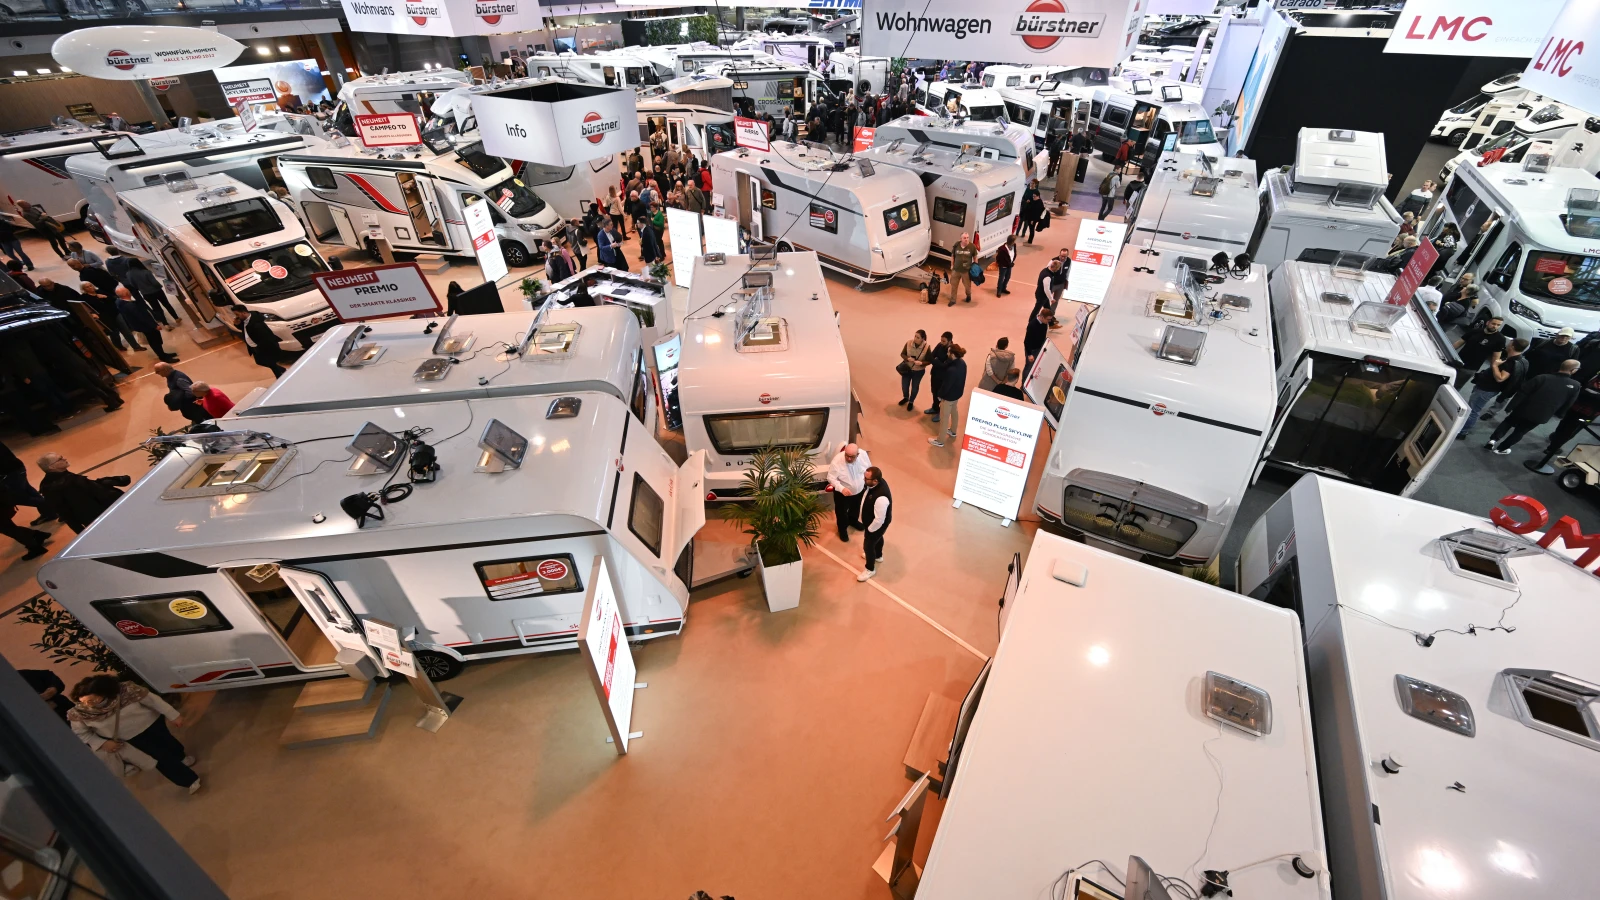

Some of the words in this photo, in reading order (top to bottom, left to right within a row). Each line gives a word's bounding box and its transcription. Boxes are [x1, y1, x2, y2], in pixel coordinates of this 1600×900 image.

[351, 2, 395, 16] Wohnvans
[406, 3, 438, 16] bürstner
[476, 2, 516, 15] bürstner
[876, 11, 992, 40] Wohnwagen
[1015, 15, 1099, 34] bürstner
[1404, 15, 1493, 42] LMC
[154, 47, 217, 58] WOHNFÜHL-MOMENTE
[1532, 35, 1585, 78] LMC
[106, 56, 150, 66] bürstner
[150, 78, 179, 86] bürstner
[249, 86, 272, 94] EDITION
[361, 116, 388, 125] NEUHEIT
[369, 124, 397, 132] CAMPEO
[505, 123, 527, 139] Info
[581, 119, 619, 136] bürstner
[327, 272, 374, 288] NEUHEIT
[354, 283, 399, 296] PREMIO
[362, 300, 386, 308] SMARTE
[386, 296, 417, 305] KLASSIKER
[1151, 405, 1176, 416] bürstner
[971, 416, 993, 427] PREMIO
[993, 422, 1008, 432] PLUS
[1008, 427, 1033, 440] SKYLINE
